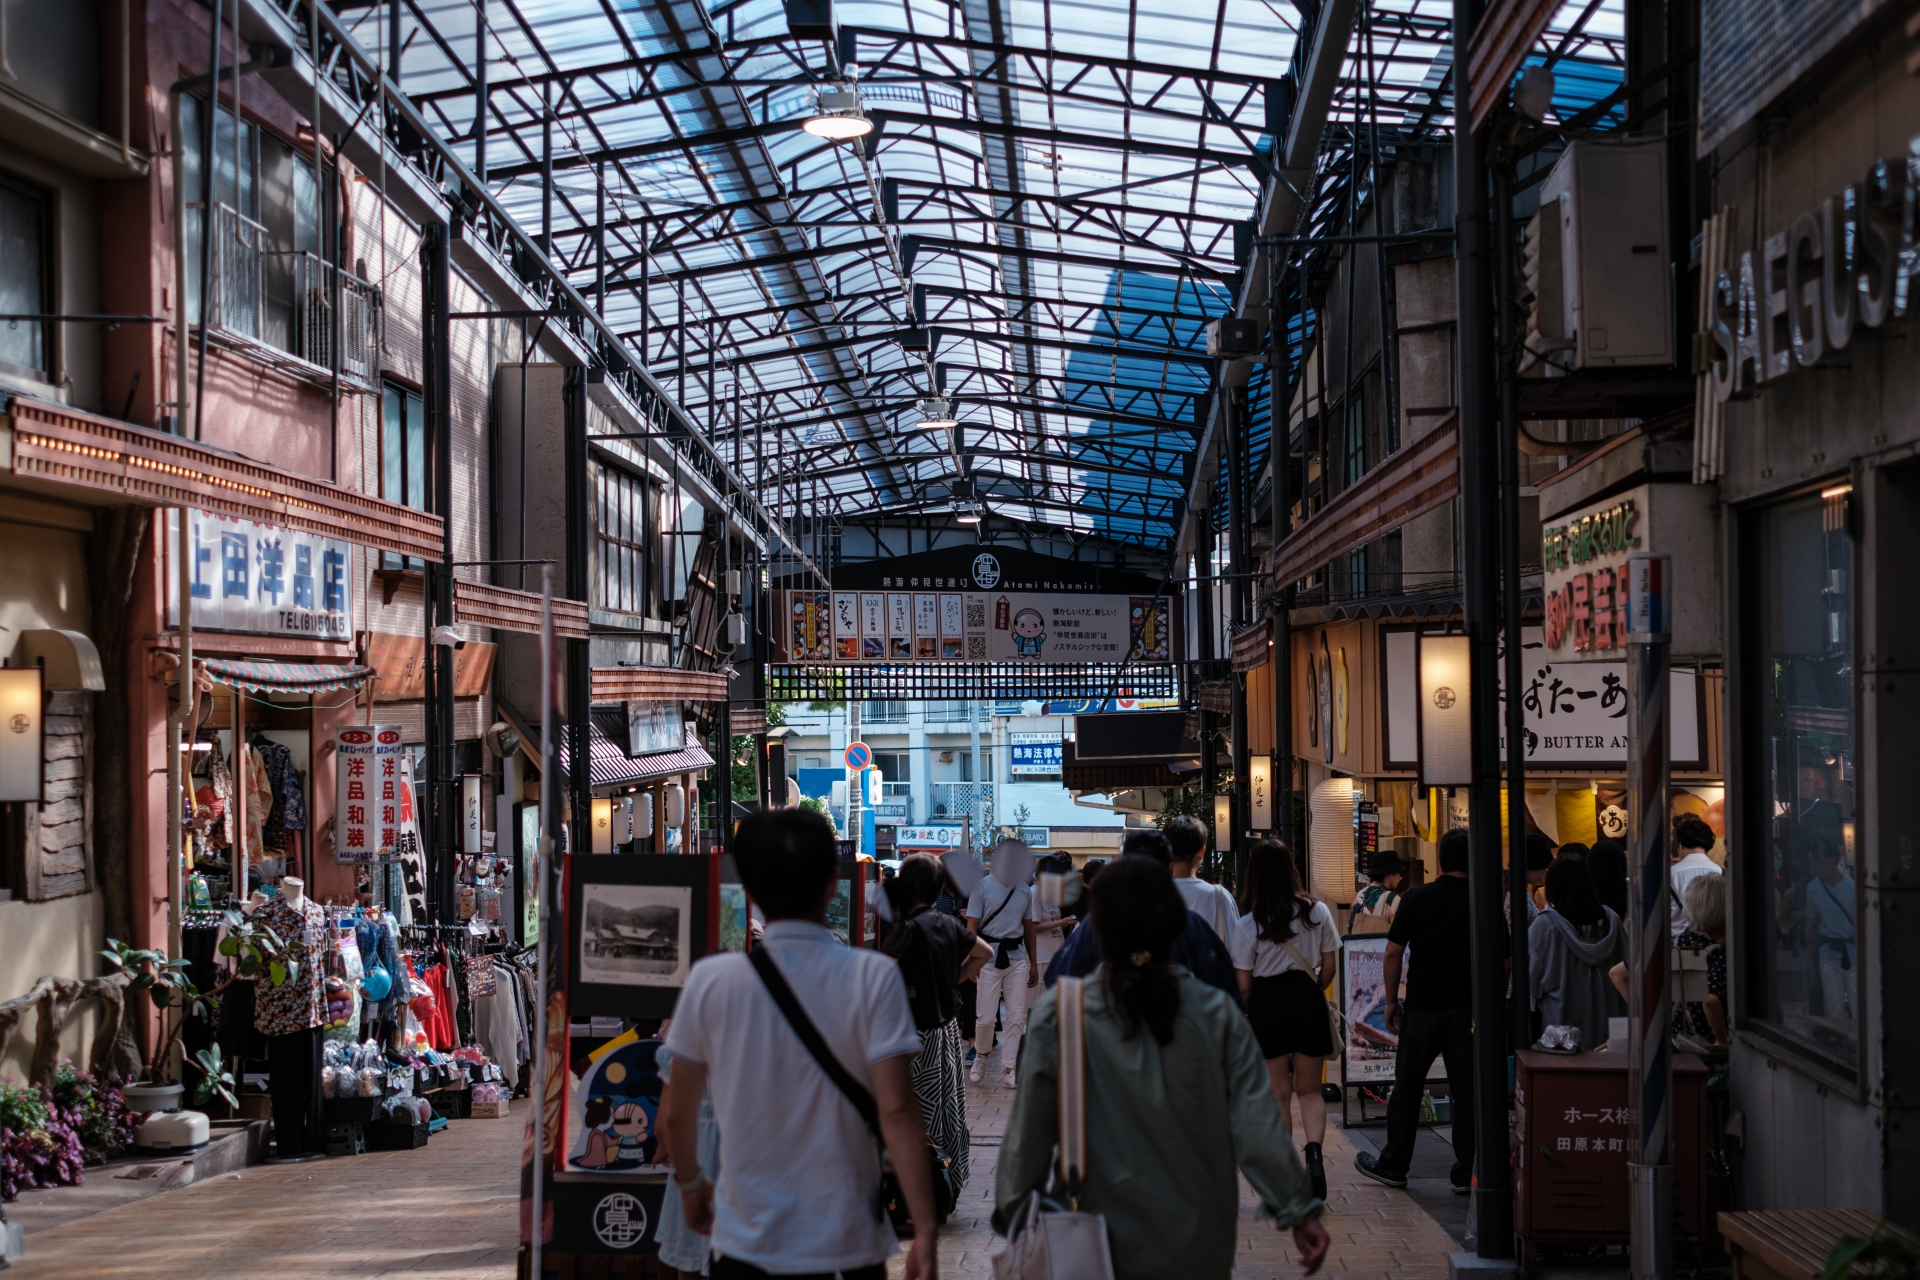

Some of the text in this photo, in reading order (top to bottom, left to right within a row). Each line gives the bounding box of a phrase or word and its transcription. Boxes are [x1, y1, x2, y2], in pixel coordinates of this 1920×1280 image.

[883, 577, 903, 587] 熱海
[1003, 580, 1038, 589] Atami
[1544, 736, 1604, 749] BUTTER
[347, 758, 365, 848] 洋品和装
[382, 758, 395, 847] 洋品和装
[1563, 1107, 1638, 1125] ホース格
